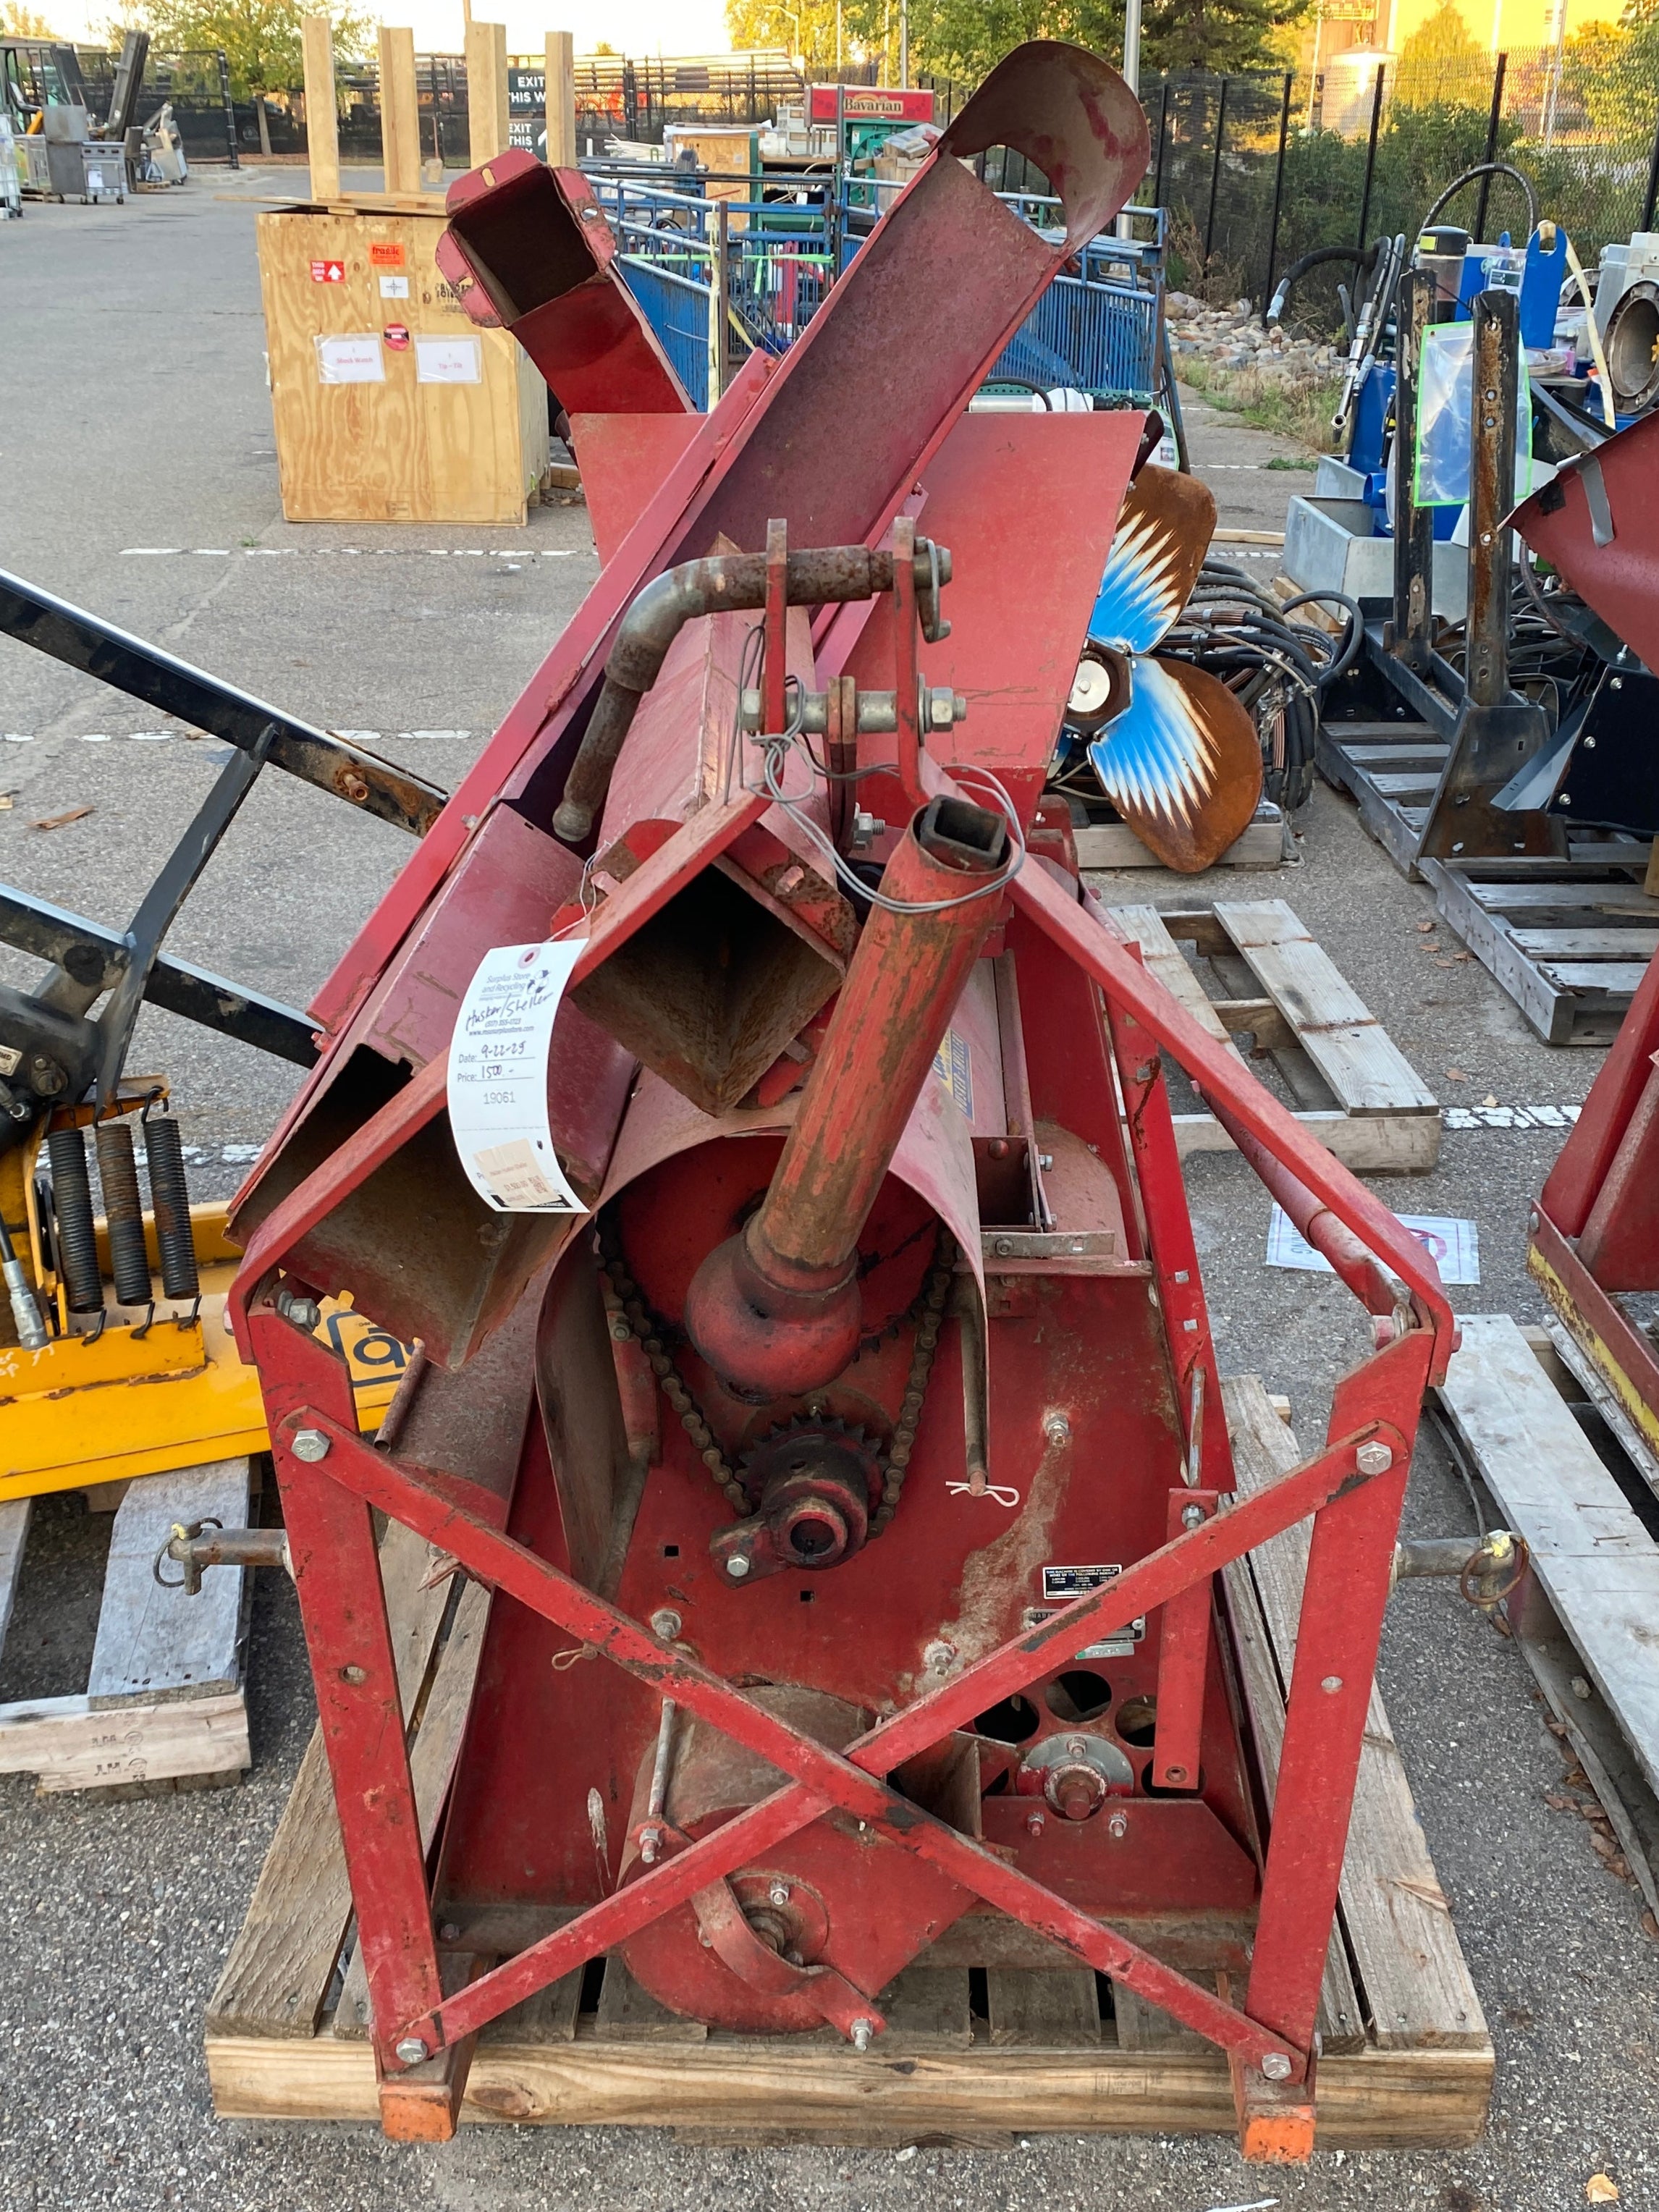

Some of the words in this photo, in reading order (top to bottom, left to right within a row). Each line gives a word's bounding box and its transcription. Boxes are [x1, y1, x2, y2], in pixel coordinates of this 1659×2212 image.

[518, 76, 545, 88] EXIT
[508, 91, 532, 103] HIS
[845, 97, 901, 112] Bavarian
[487, 975, 512, 984] Surplus
[458, 1054, 477, 1063] Date:
[457, 1073, 477, 1082] Price:
[484, 1092, 515, 1105] 19061
